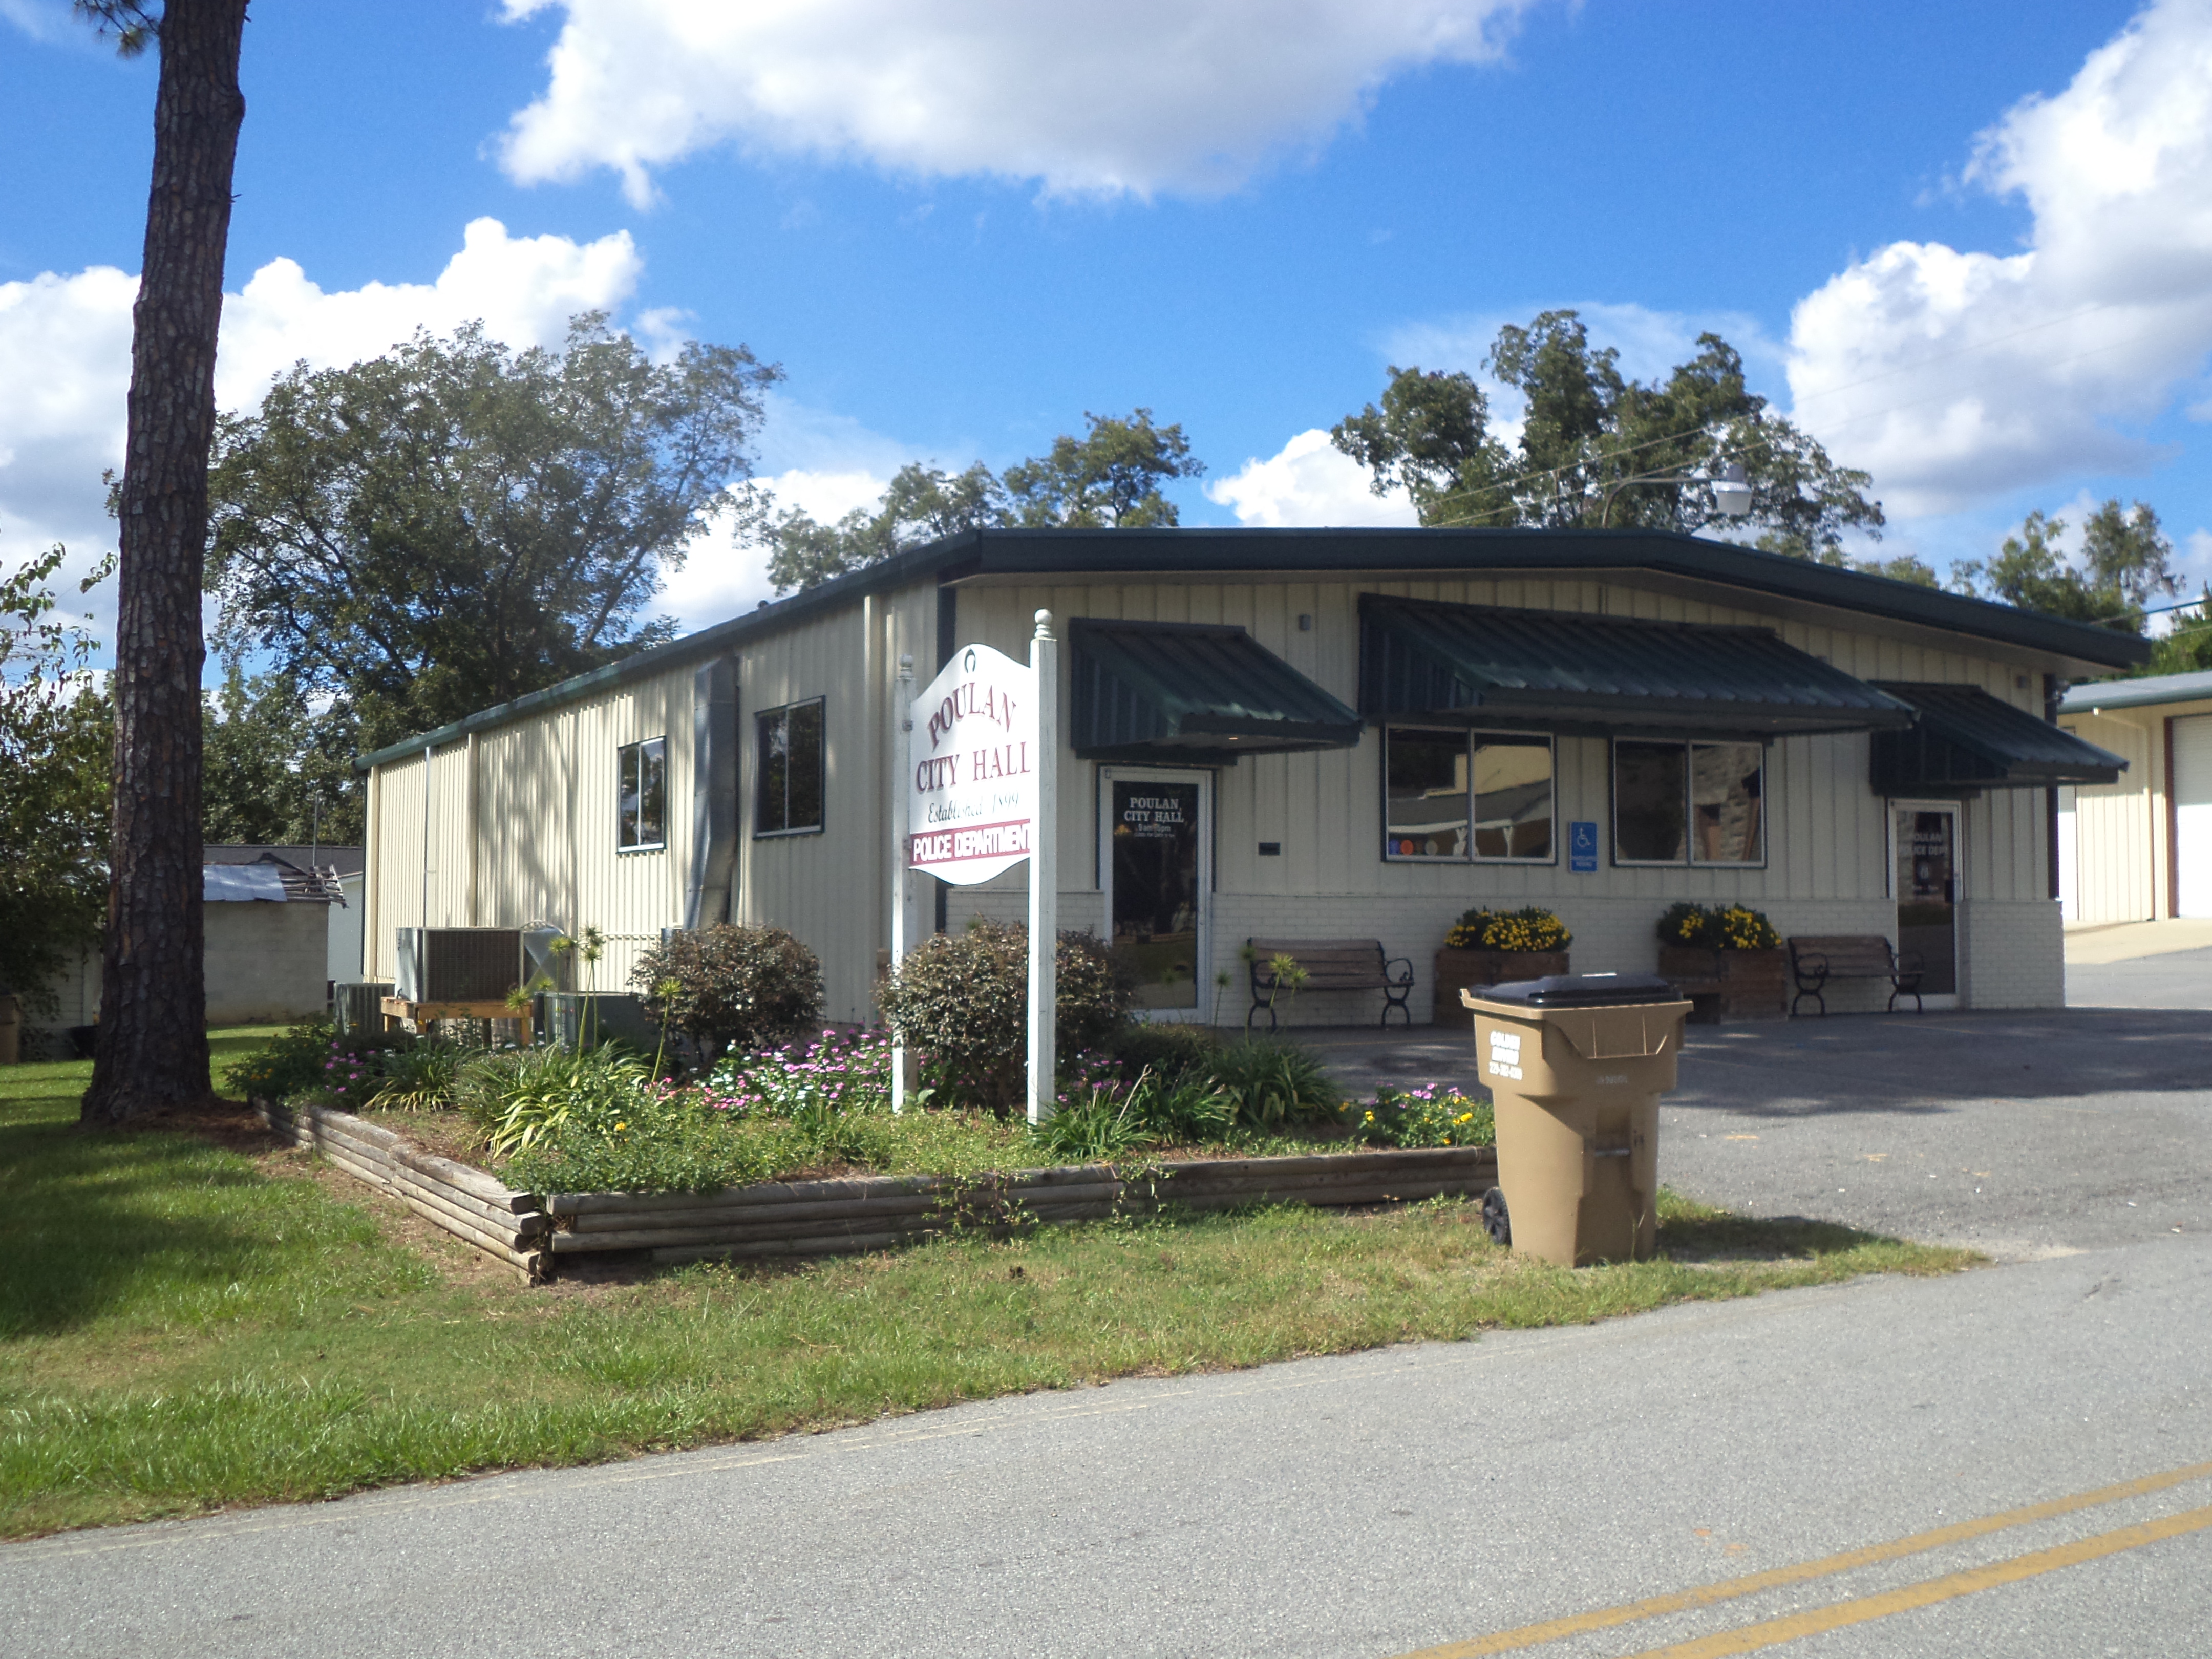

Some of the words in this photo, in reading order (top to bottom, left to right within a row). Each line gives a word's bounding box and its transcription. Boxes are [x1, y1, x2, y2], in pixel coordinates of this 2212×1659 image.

[928, 683, 1016, 753] POULAN
[916, 754, 960, 792] CITY
[973, 741, 1030, 781] HALL
[928, 795, 983, 823] Established
[1124, 811, 1150, 821] CITY
[1155, 811, 1184, 823] HALL
[1130, 797, 1179, 809] POULAN
[914, 834, 952, 861] POLICE
[954, 824, 1030, 858] DEPARTMENT
[1909, 833, 1942, 842] OULAN
